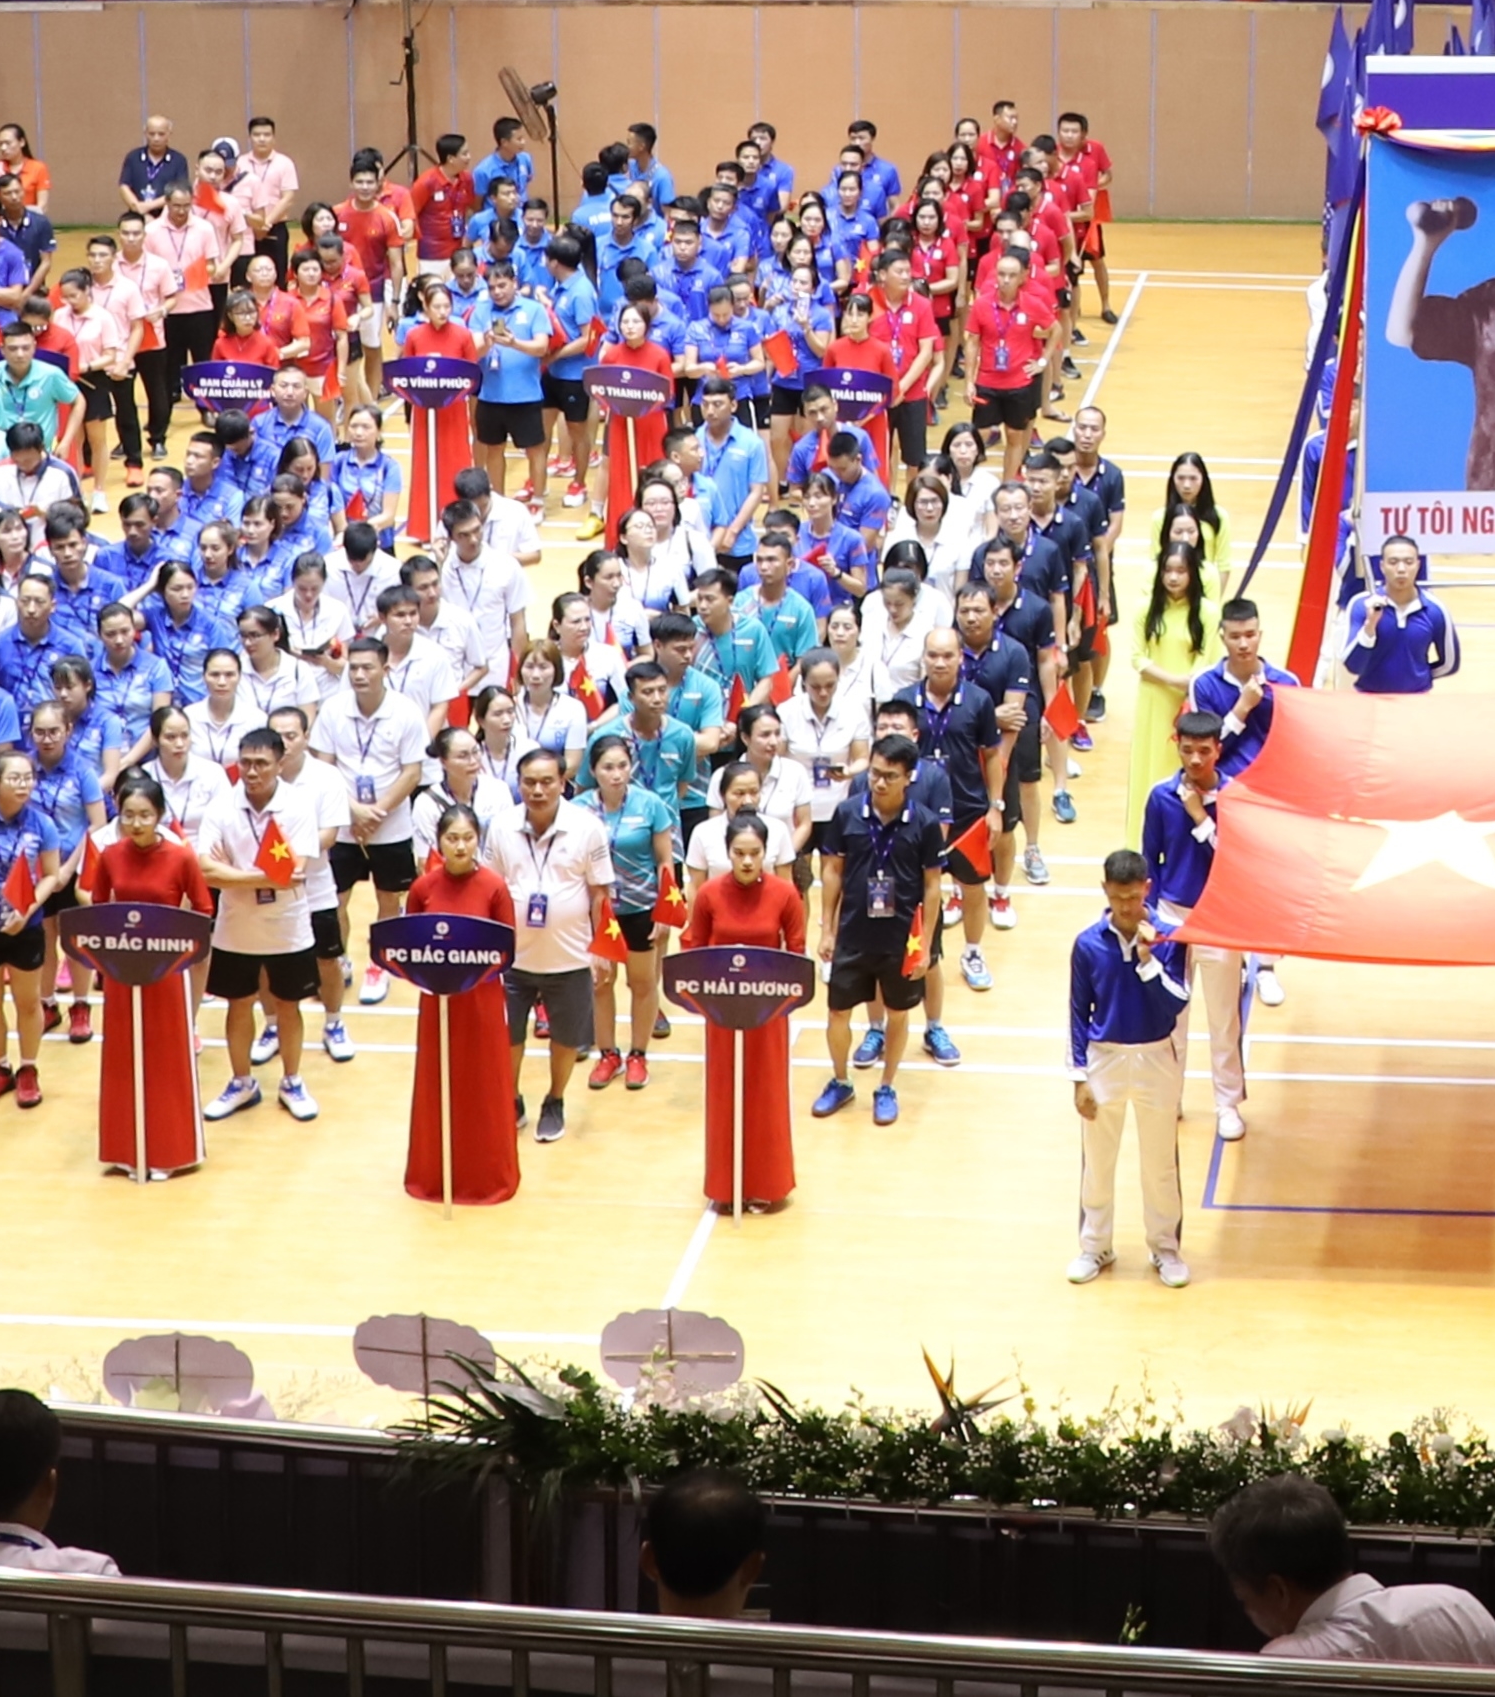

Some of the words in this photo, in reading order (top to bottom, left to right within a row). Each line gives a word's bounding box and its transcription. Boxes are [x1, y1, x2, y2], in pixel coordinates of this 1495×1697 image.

[392, 377, 407, 388] PC
[591, 384, 605, 396] PC
[607, 385, 642, 399] THANH
[1380, 505, 1412, 537] TỰ
[1418, 502, 1454, 536] TÔI
[77, 935, 101, 949] PC
[105, 932, 143, 950] BẮC
[147, 937, 194, 952] NINH
[385, 948, 408, 963] PC
[411, 944, 445, 963] BẮC
[448, 949, 502, 964] GIANG
[675, 979, 700, 993] PC
[703, 977, 735, 995] HẢI
[738, 979, 803, 997] DƯƠNG
